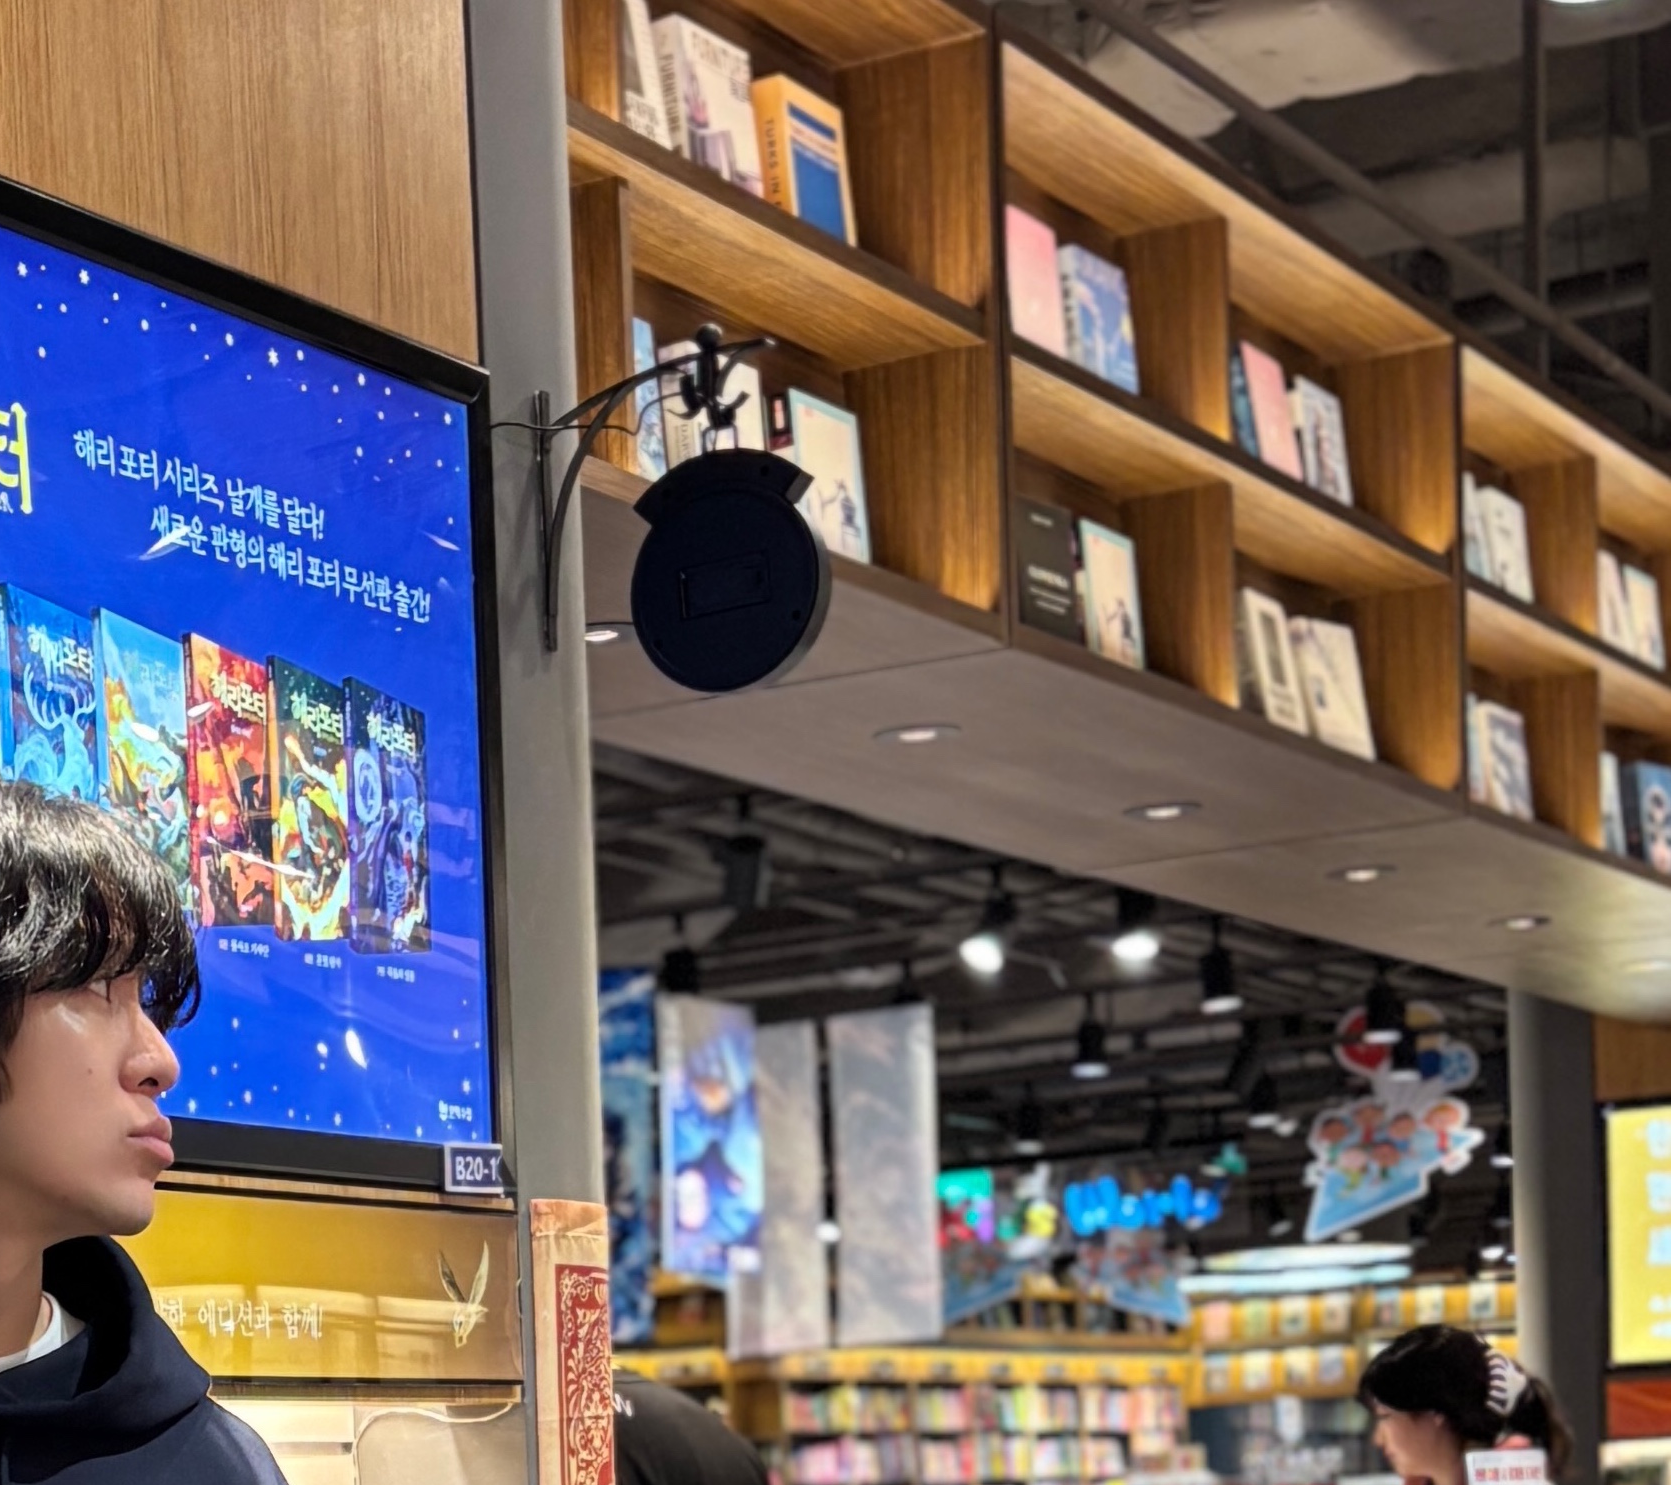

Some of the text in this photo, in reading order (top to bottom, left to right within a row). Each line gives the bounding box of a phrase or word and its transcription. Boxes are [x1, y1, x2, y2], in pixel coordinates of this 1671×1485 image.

[73, 428, 116, 477] 해리
[119, 445, 160, 491] 포터
[226, 477, 282, 528] 날개를
[282, 496, 325, 541] 달다!
[150, 504, 432, 624] 새로운 판형의 해리 포터 무선판 출간!
[455, 1155, 497, 1182] B20-1
[198, 1297, 272, 1339] 에디션과
[282, 1301, 324, 1342] 함께!
